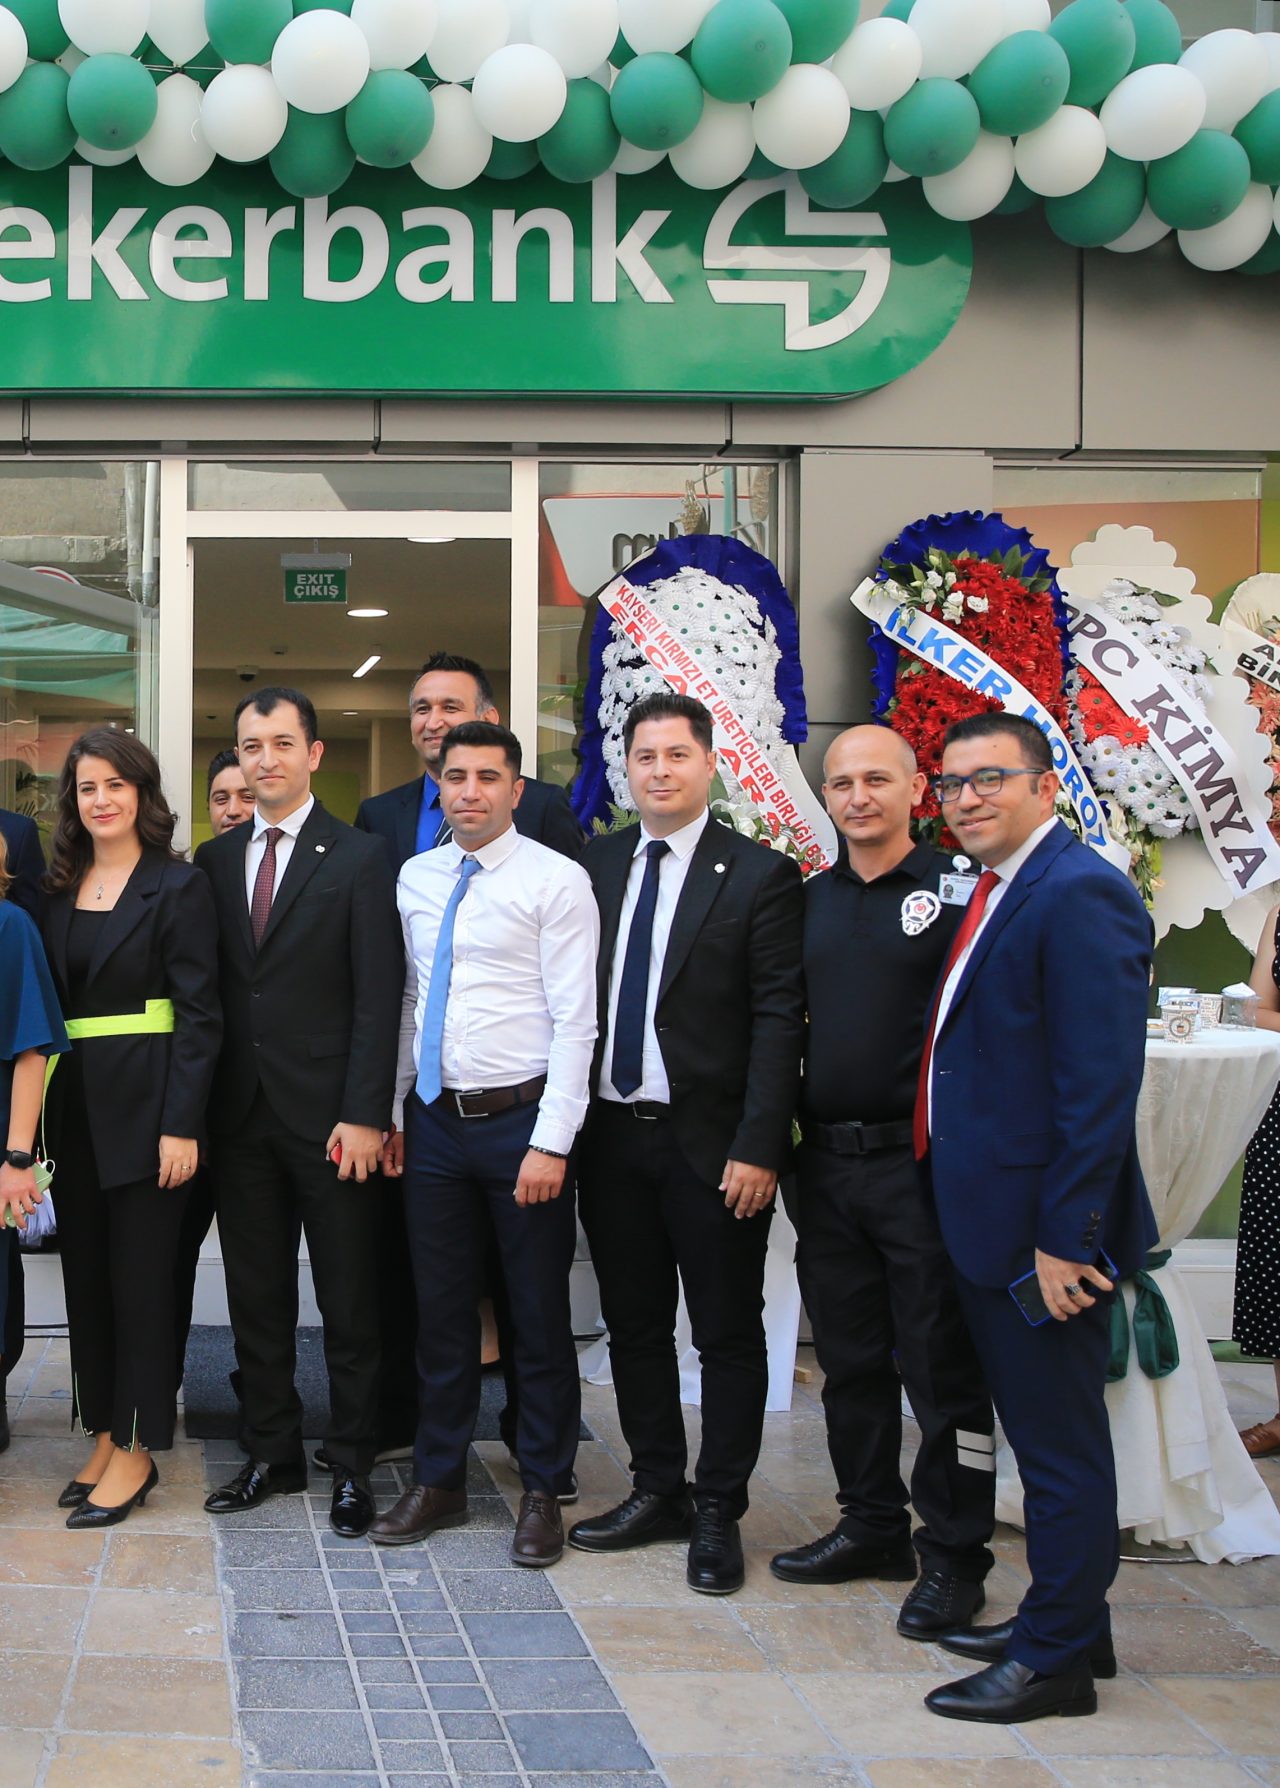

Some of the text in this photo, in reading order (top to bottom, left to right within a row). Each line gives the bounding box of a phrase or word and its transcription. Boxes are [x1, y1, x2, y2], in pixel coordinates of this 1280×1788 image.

[293, 585, 339, 598] ÇIKIŞ
[296, 573, 335, 585] EXIT
[615, 584, 665, 634] KAYSERİ
[655, 630, 703, 683] KIRMIZI
[696, 680, 719, 702] ET
[711, 698, 782, 792] ÜRETİCİLERİ
[769, 788, 817, 846] BİRLİĞİ
[1131, 683, 1268, 890] KİMYA
